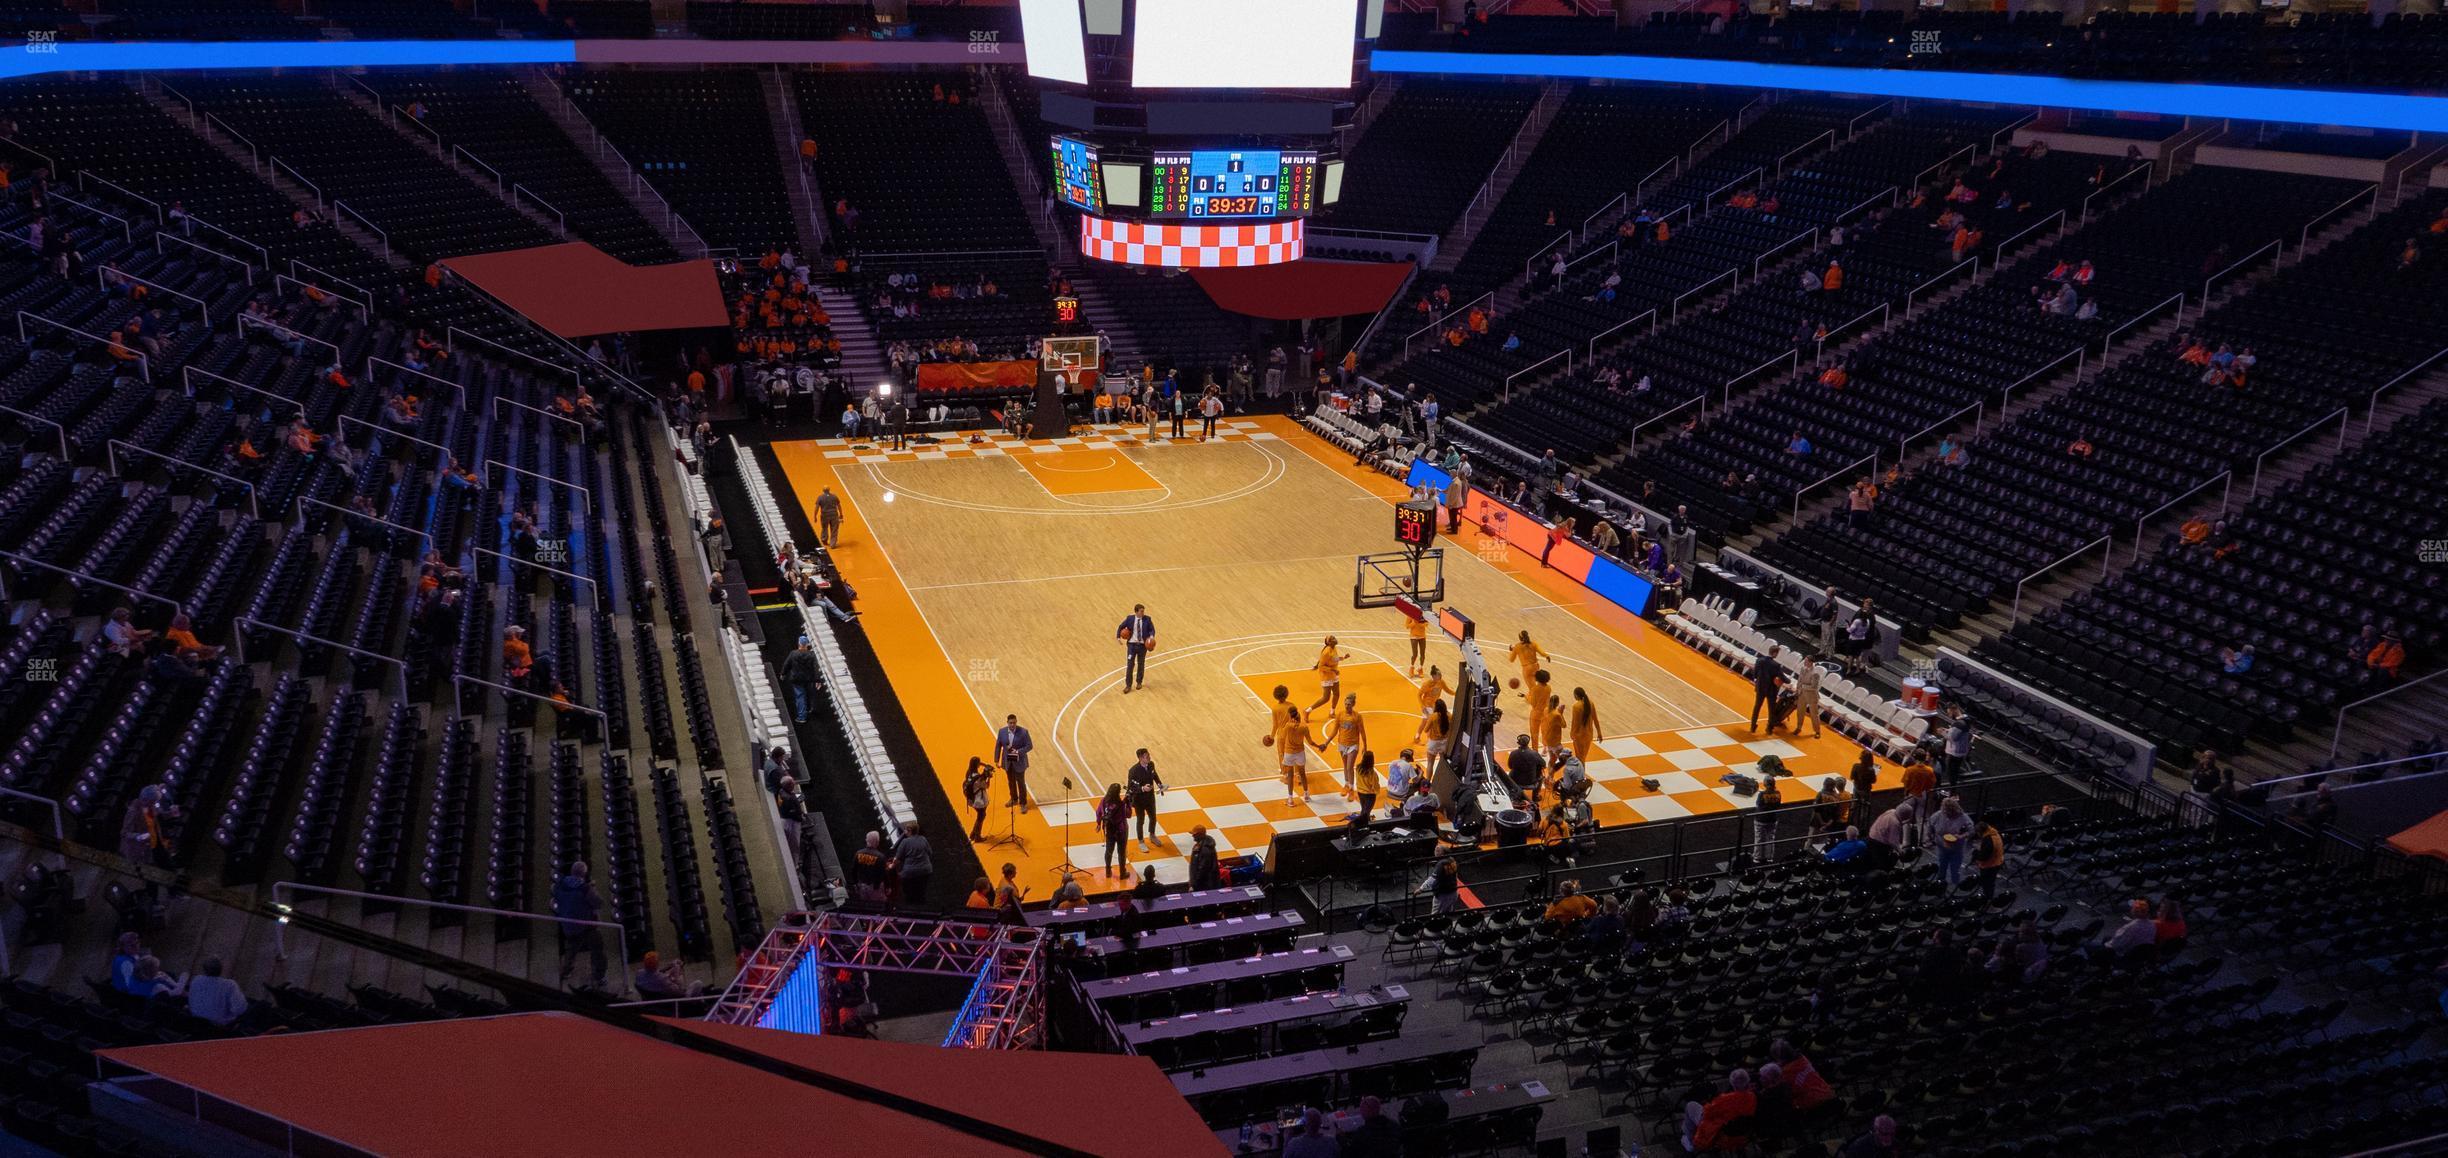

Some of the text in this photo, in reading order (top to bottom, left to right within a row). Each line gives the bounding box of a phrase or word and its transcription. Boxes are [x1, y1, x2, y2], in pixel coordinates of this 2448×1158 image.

[1234, 161, 1238, 172] 1
[1200, 179, 1207, 190] 0
[1244, 184, 1250, 192] 4
[1262, 178, 1269, 190] 0
[1195, 206, 1202, 214] 0
[1209, 198, 1257, 213] 39:37
[1057, 300, 1077, 309] 39:37
[1060, 308, 1073, 320] 30
[1398, 508, 1425, 523] 39:37
[1402, 520, 1420, 541] 30
